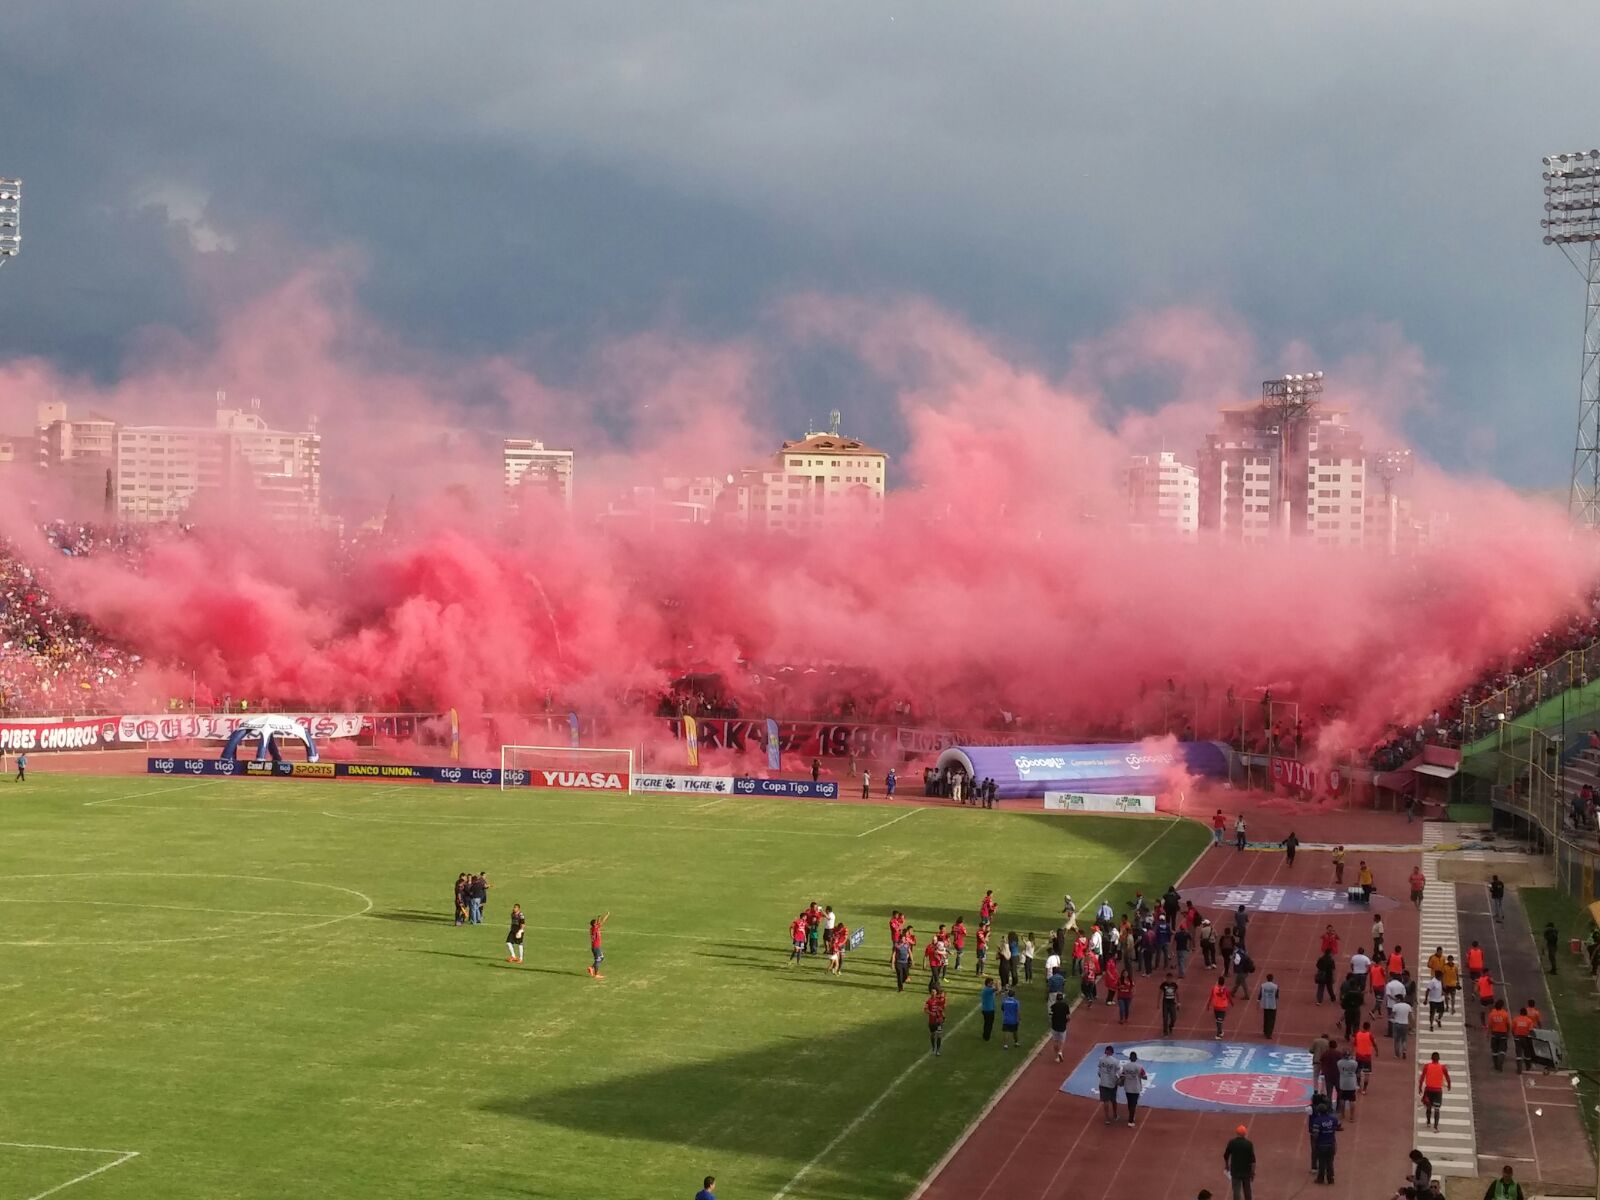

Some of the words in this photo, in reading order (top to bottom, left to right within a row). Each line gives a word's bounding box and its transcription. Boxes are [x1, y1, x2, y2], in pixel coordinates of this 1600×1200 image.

[0, 728, 36, 749] PIBES
[40, 724, 99, 749] CHORROS
[295, 765, 332, 775] SPORTS
[348, 765, 379, 775] BANCO
[381, 767, 413, 776] UNION
[542, 771, 622, 789] YUASA
[634, 778, 663, 787] TIGRE
[684, 779, 713, 789] TIGRE
[762, 781, 786, 792] Copa
[789, 782, 809, 794] Tigo
